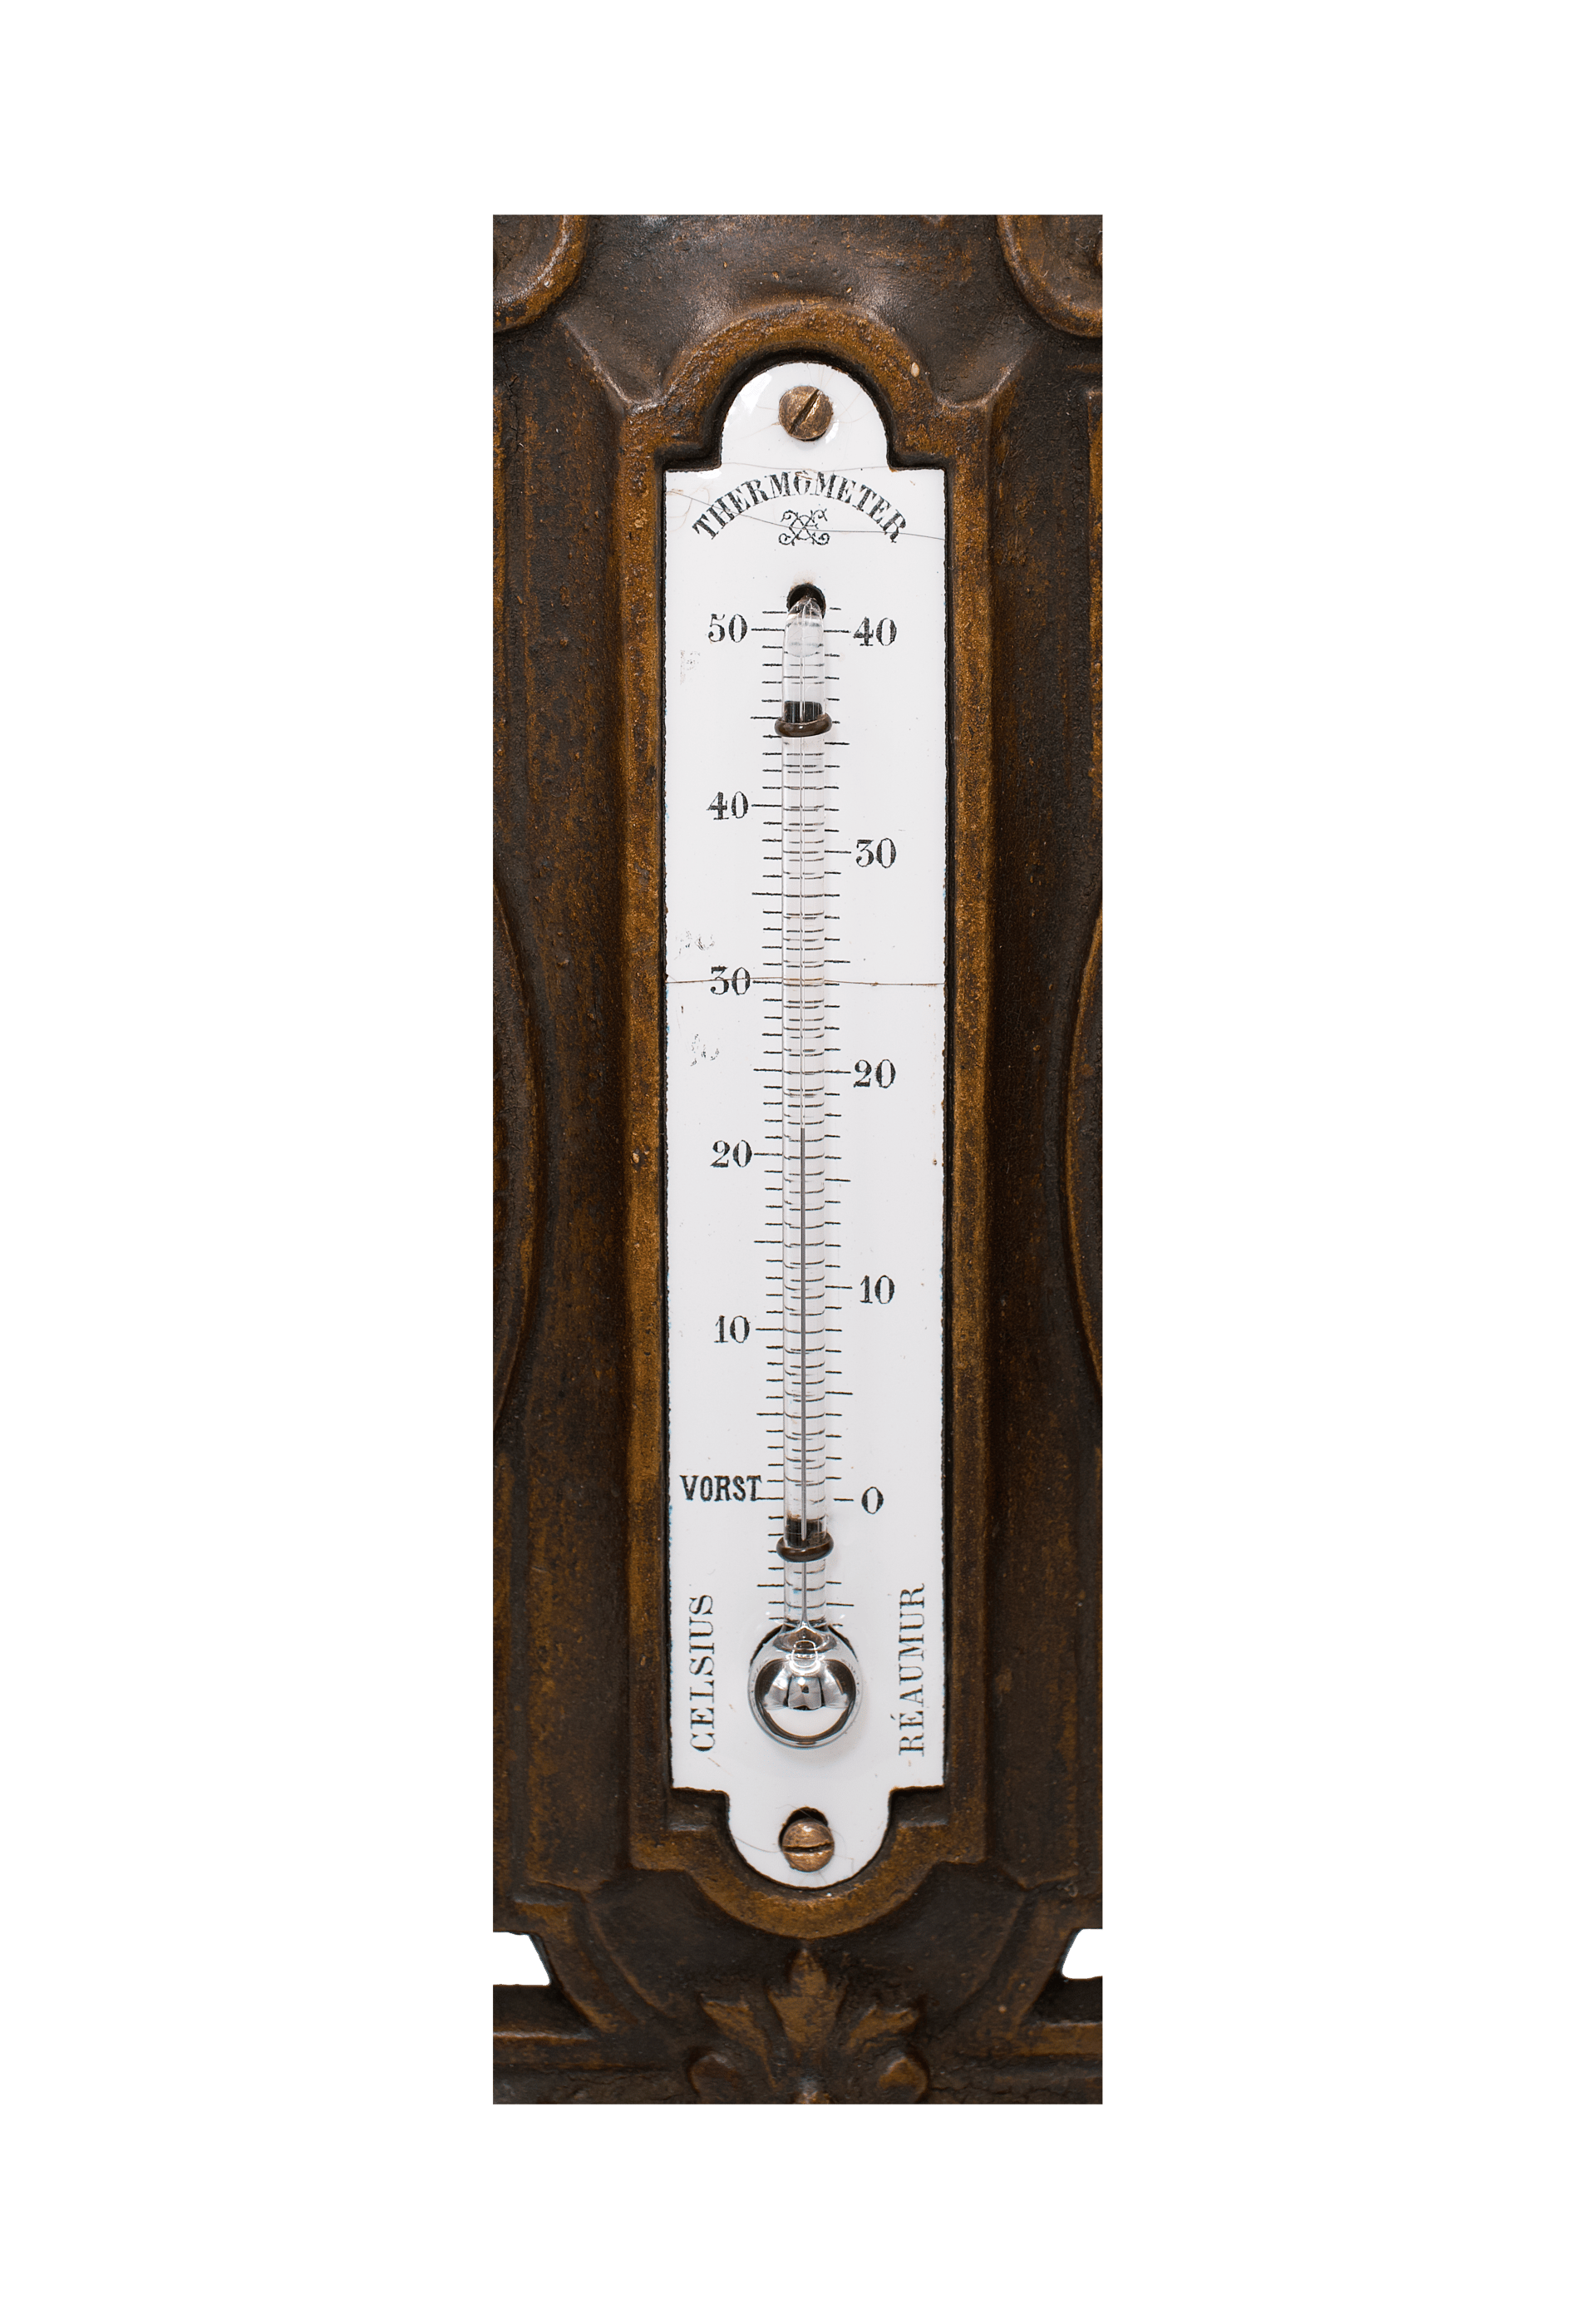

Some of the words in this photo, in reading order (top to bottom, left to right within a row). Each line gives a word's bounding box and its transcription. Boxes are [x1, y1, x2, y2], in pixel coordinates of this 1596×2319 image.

[692, 471, 907, 543] THERMOMETER
[707, 614, 748, 644] 50
[852, 616, 898, 647] 40
[706, 791, 750, 820] 40
[855, 836, 897, 869] 30
[710, 965, 751, 995] 30
[853, 1058, 896, 1089] 20
[710, 1139, 753, 1168] 20
[860, 1275, 895, 1305] 10
[713, 1315, 751, 1344] 10
[679, 1474, 761, 1502] VORST
[860, 1486, 884, 1514] 0
[688, 1593, 716, 1752] CELSIUS
[889, 1582, 925, 1757] RÉAUMUR
